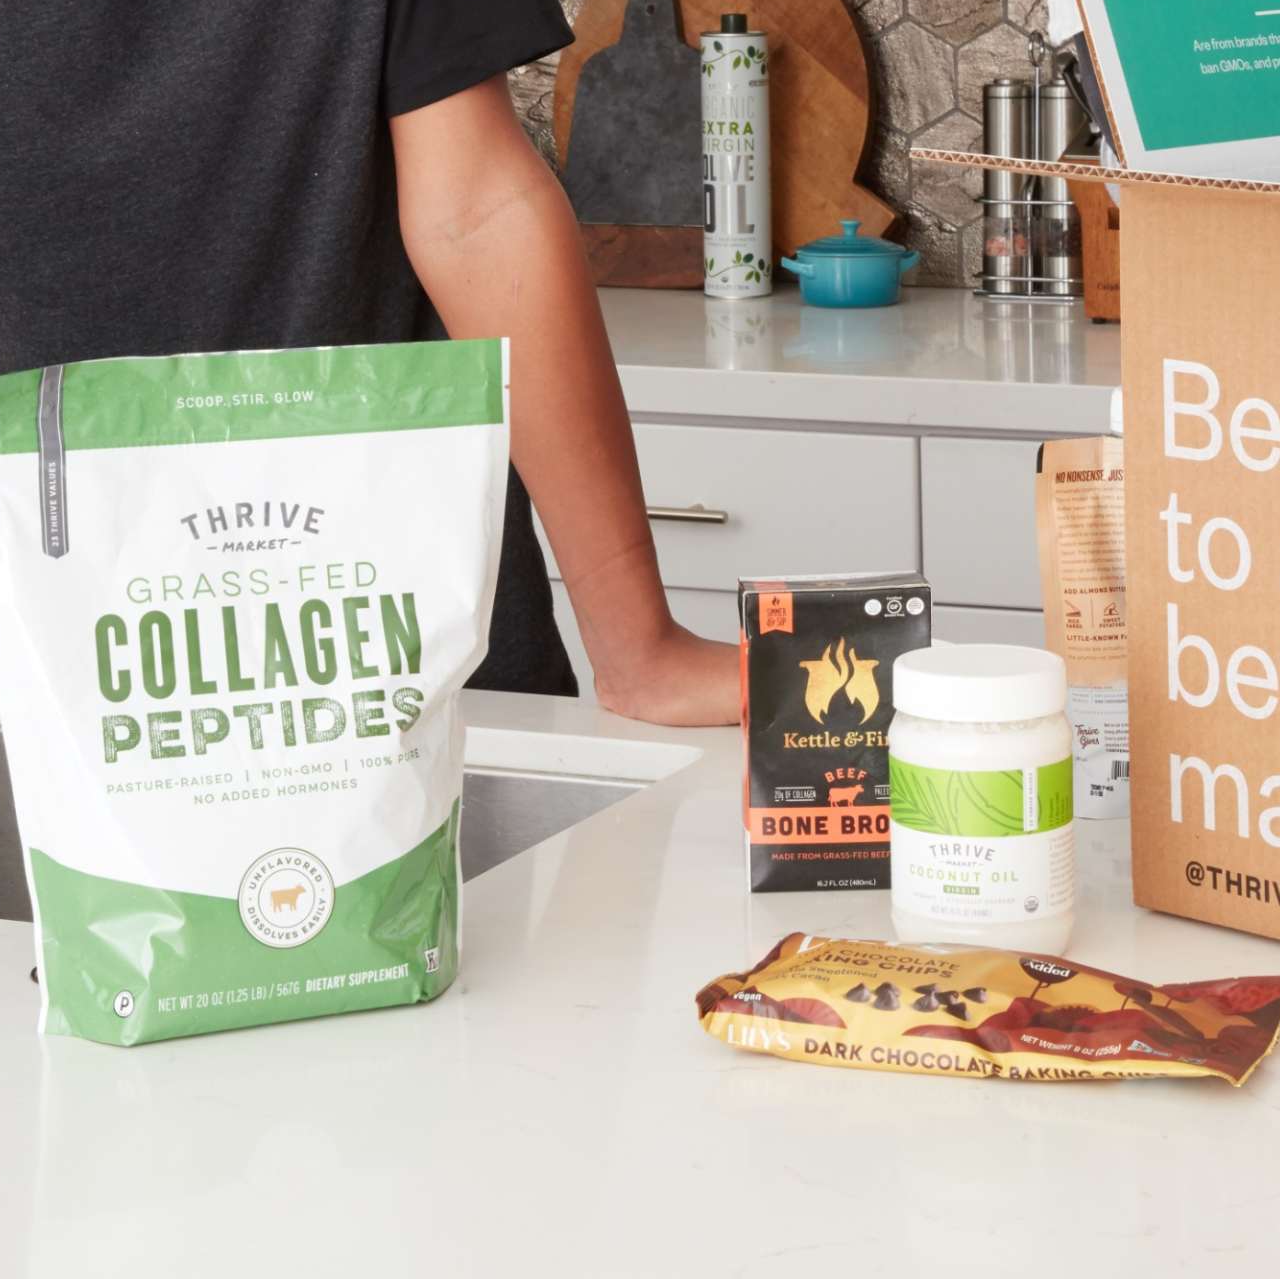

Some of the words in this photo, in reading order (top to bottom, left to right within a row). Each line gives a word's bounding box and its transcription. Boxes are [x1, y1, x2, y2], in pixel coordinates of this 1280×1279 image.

[1193, 39, 1211, 52] Are
[1211, 37, 1234, 51] from
[1234, 34, 1268, 49] brands
[1200, 61, 1219, 74] ban
[1219, 58, 1254, 73] GMOs,
[1254, 54, 1271, 70] and
[232, 393, 269, 406] STIR.
[273, 390, 314, 404] GLOW
[48, 462, 57, 497] VALUES
[49, 499, 59, 533] THRIVE
[180, 501, 325, 540] THRIVE
[222, 538, 288, 553] MARKET
[1159, 492, 1252, 591] to
[126, 561, 377, 604] GRASS-FED
[95, 592, 422, 703] COLLAGEN
[101, 686, 424, 764] PEPTIDES
[784, 731, 840, 748] Kettle
[844, 731, 864, 748] &
[106, 772, 233, 794] PASTURE-RAISED
[262, 762, 333, 779] NON-GMO
[360, 755, 393, 769] 100%
[398, 748, 421, 763] PURE
[824, 767, 868, 783] BEEF
[194, 794, 215, 806] NO
[221, 787, 271, 803] ADDED
[277, 778, 359, 797] HORMONES
[792, 789, 817, 799] COLLAGEN
[762, 815, 829, 836] BONE
[772, 852, 795, 860] MADE
[797, 852, 820, 860] FROM
[823, 851, 869, 860] GRASS-FED
[929, 843, 996, 862] THRIVE
[248, 856, 322, 891] UNFLAVORED
[910, 864, 981, 882] COCONUT
[991, 871, 1019, 882] OIL
[247, 906, 299, 940] DISSOLVES
[301, 898, 327, 934] EASILY
[839, 949, 961, 970] CHOCOLATE
[878, 961, 953, 979] CHIPS
[1024, 960, 1071, 978] Added
[158, 996, 177, 1013] NET
[179, 993, 194, 1010] WT
[196, 992, 210, 1008] 20
[211, 990, 224, 1006] OZ
[251, 987, 268, 1003] LB)
[276, 980, 300, 998] 567G
[305, 974, 346, 994] DIETARY
[348, 963, 409, 987] SUPPLEMENT
[732, 991, 762, 1002] Vegan
[1020, 1034, 1038, 1045] NET
[804, 1038, 863, 1062] DARK
[870, 1047, 1003, 1078] CHOCOLATE
